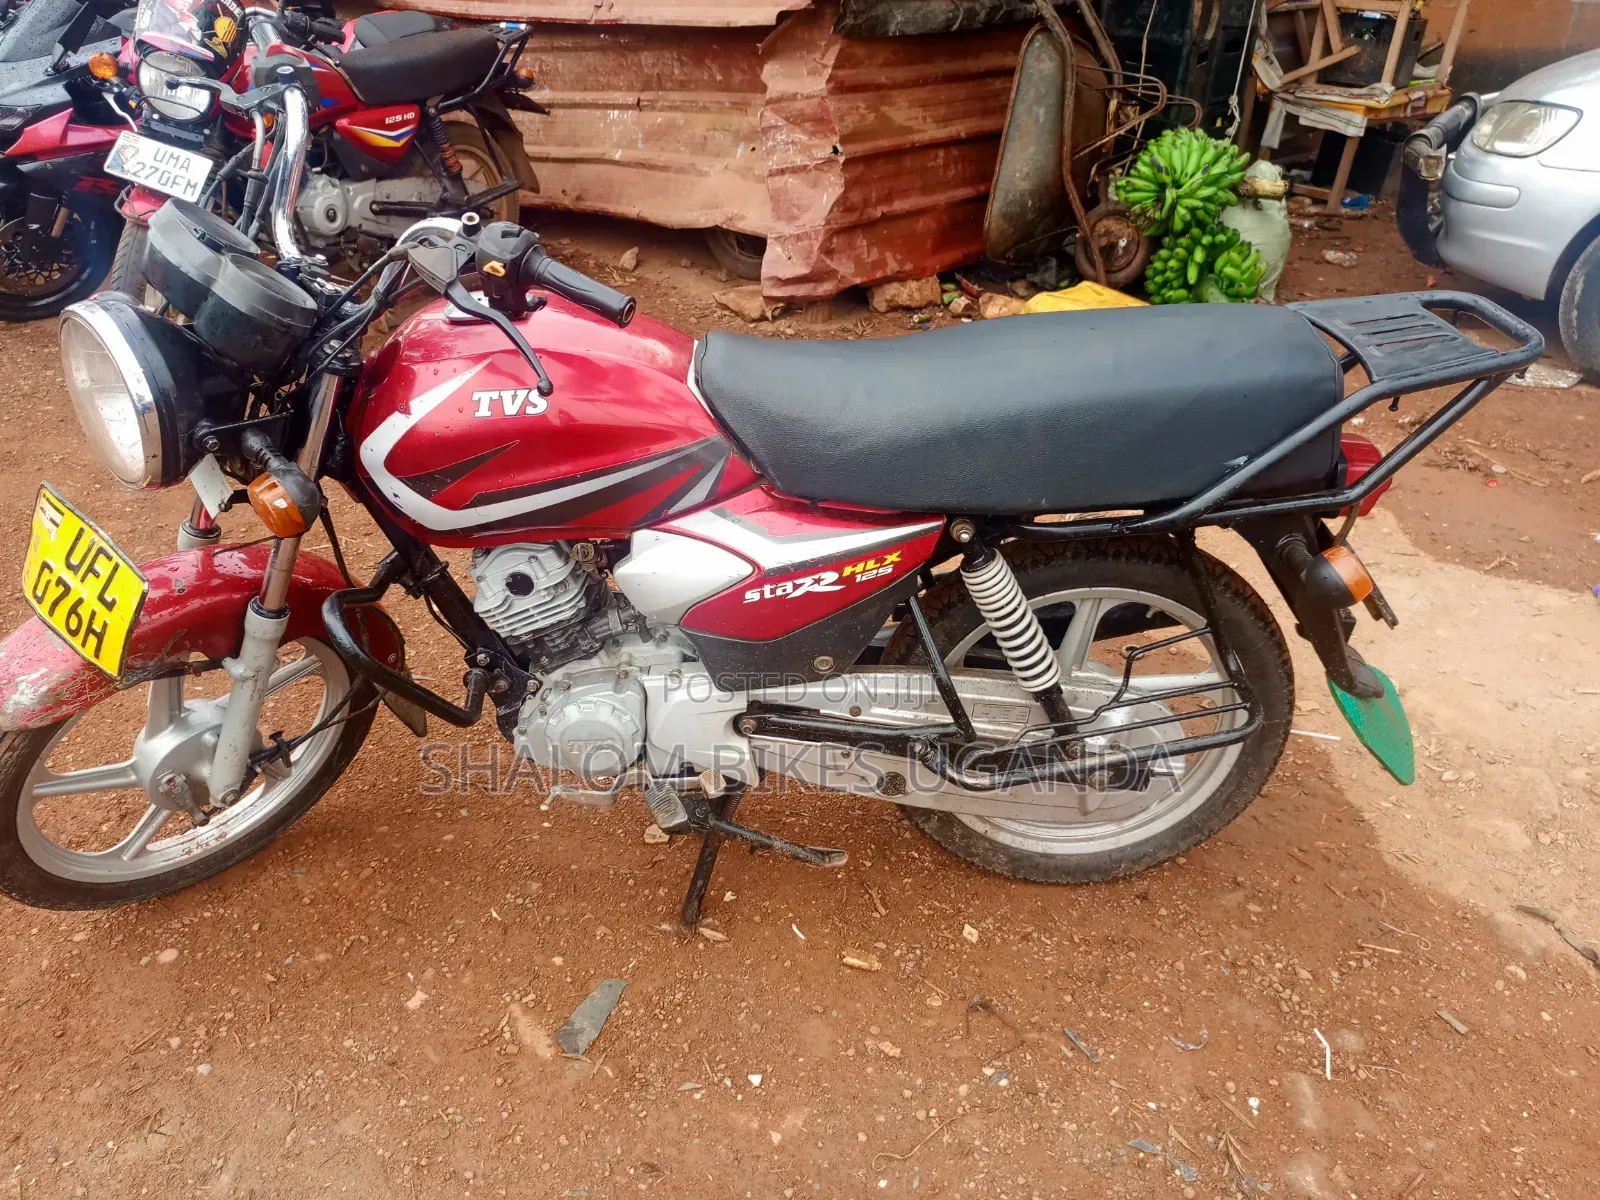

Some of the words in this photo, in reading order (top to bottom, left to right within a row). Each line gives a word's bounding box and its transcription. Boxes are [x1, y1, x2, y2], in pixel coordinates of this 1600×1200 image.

[385, 115, 402, 125] 125
[403, 112, 416, 120] HD
[152, 147, 191, 174] UMA
[131, 161, 199, 197] 270FM
[471, 388, 549, 418] TVS
[64, 526, 120, 613] UFL
[842, 550, 902, 577] HLX
[855, 564, 894, 583] 125
[32, 560, 109, 660] 076H
